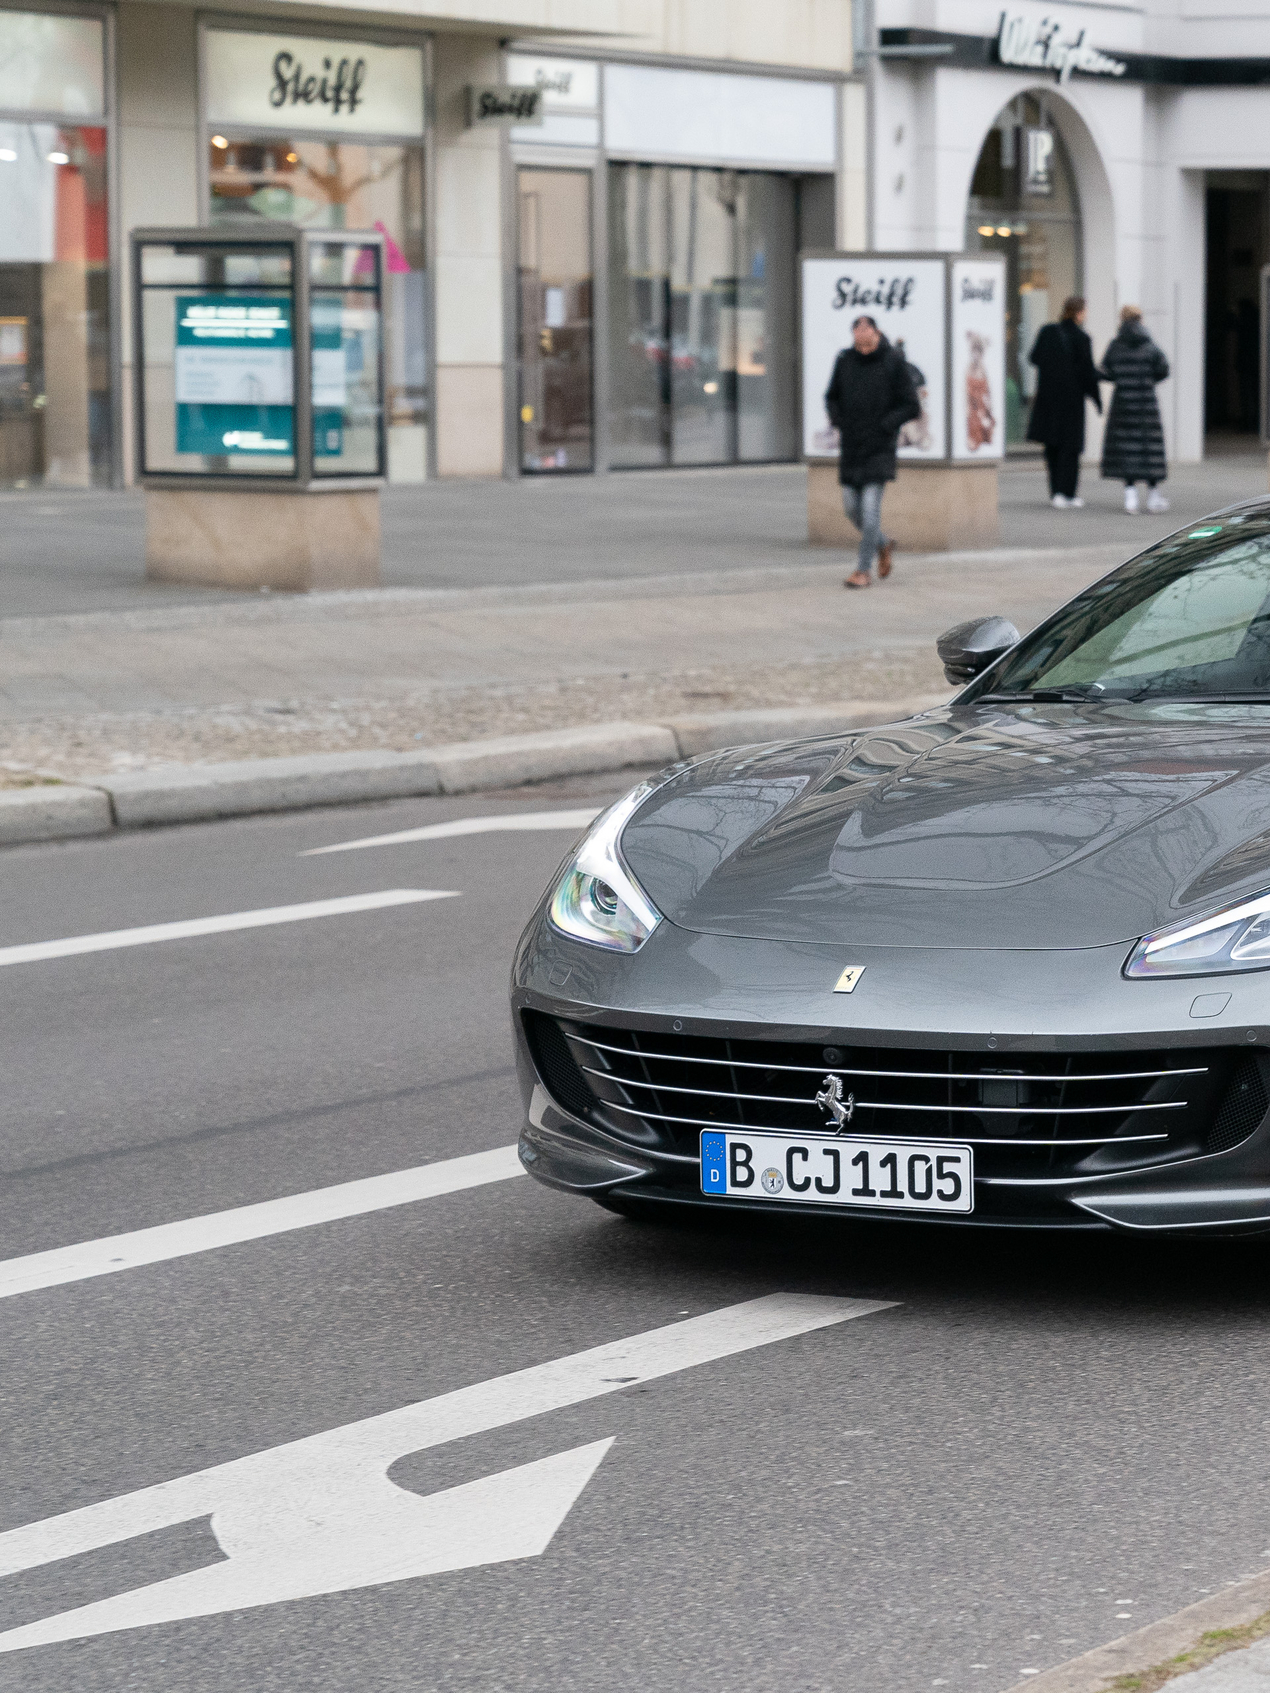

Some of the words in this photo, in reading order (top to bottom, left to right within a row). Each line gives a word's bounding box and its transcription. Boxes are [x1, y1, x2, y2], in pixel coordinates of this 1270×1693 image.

[269, 51, 366, 115] Steiff
[478, 90, 539, 120] Steiff
[832, 276, 915, 311] Steiff
[711, 1169, 720, 1182] D
[729, 1142, 755, 1188] B
